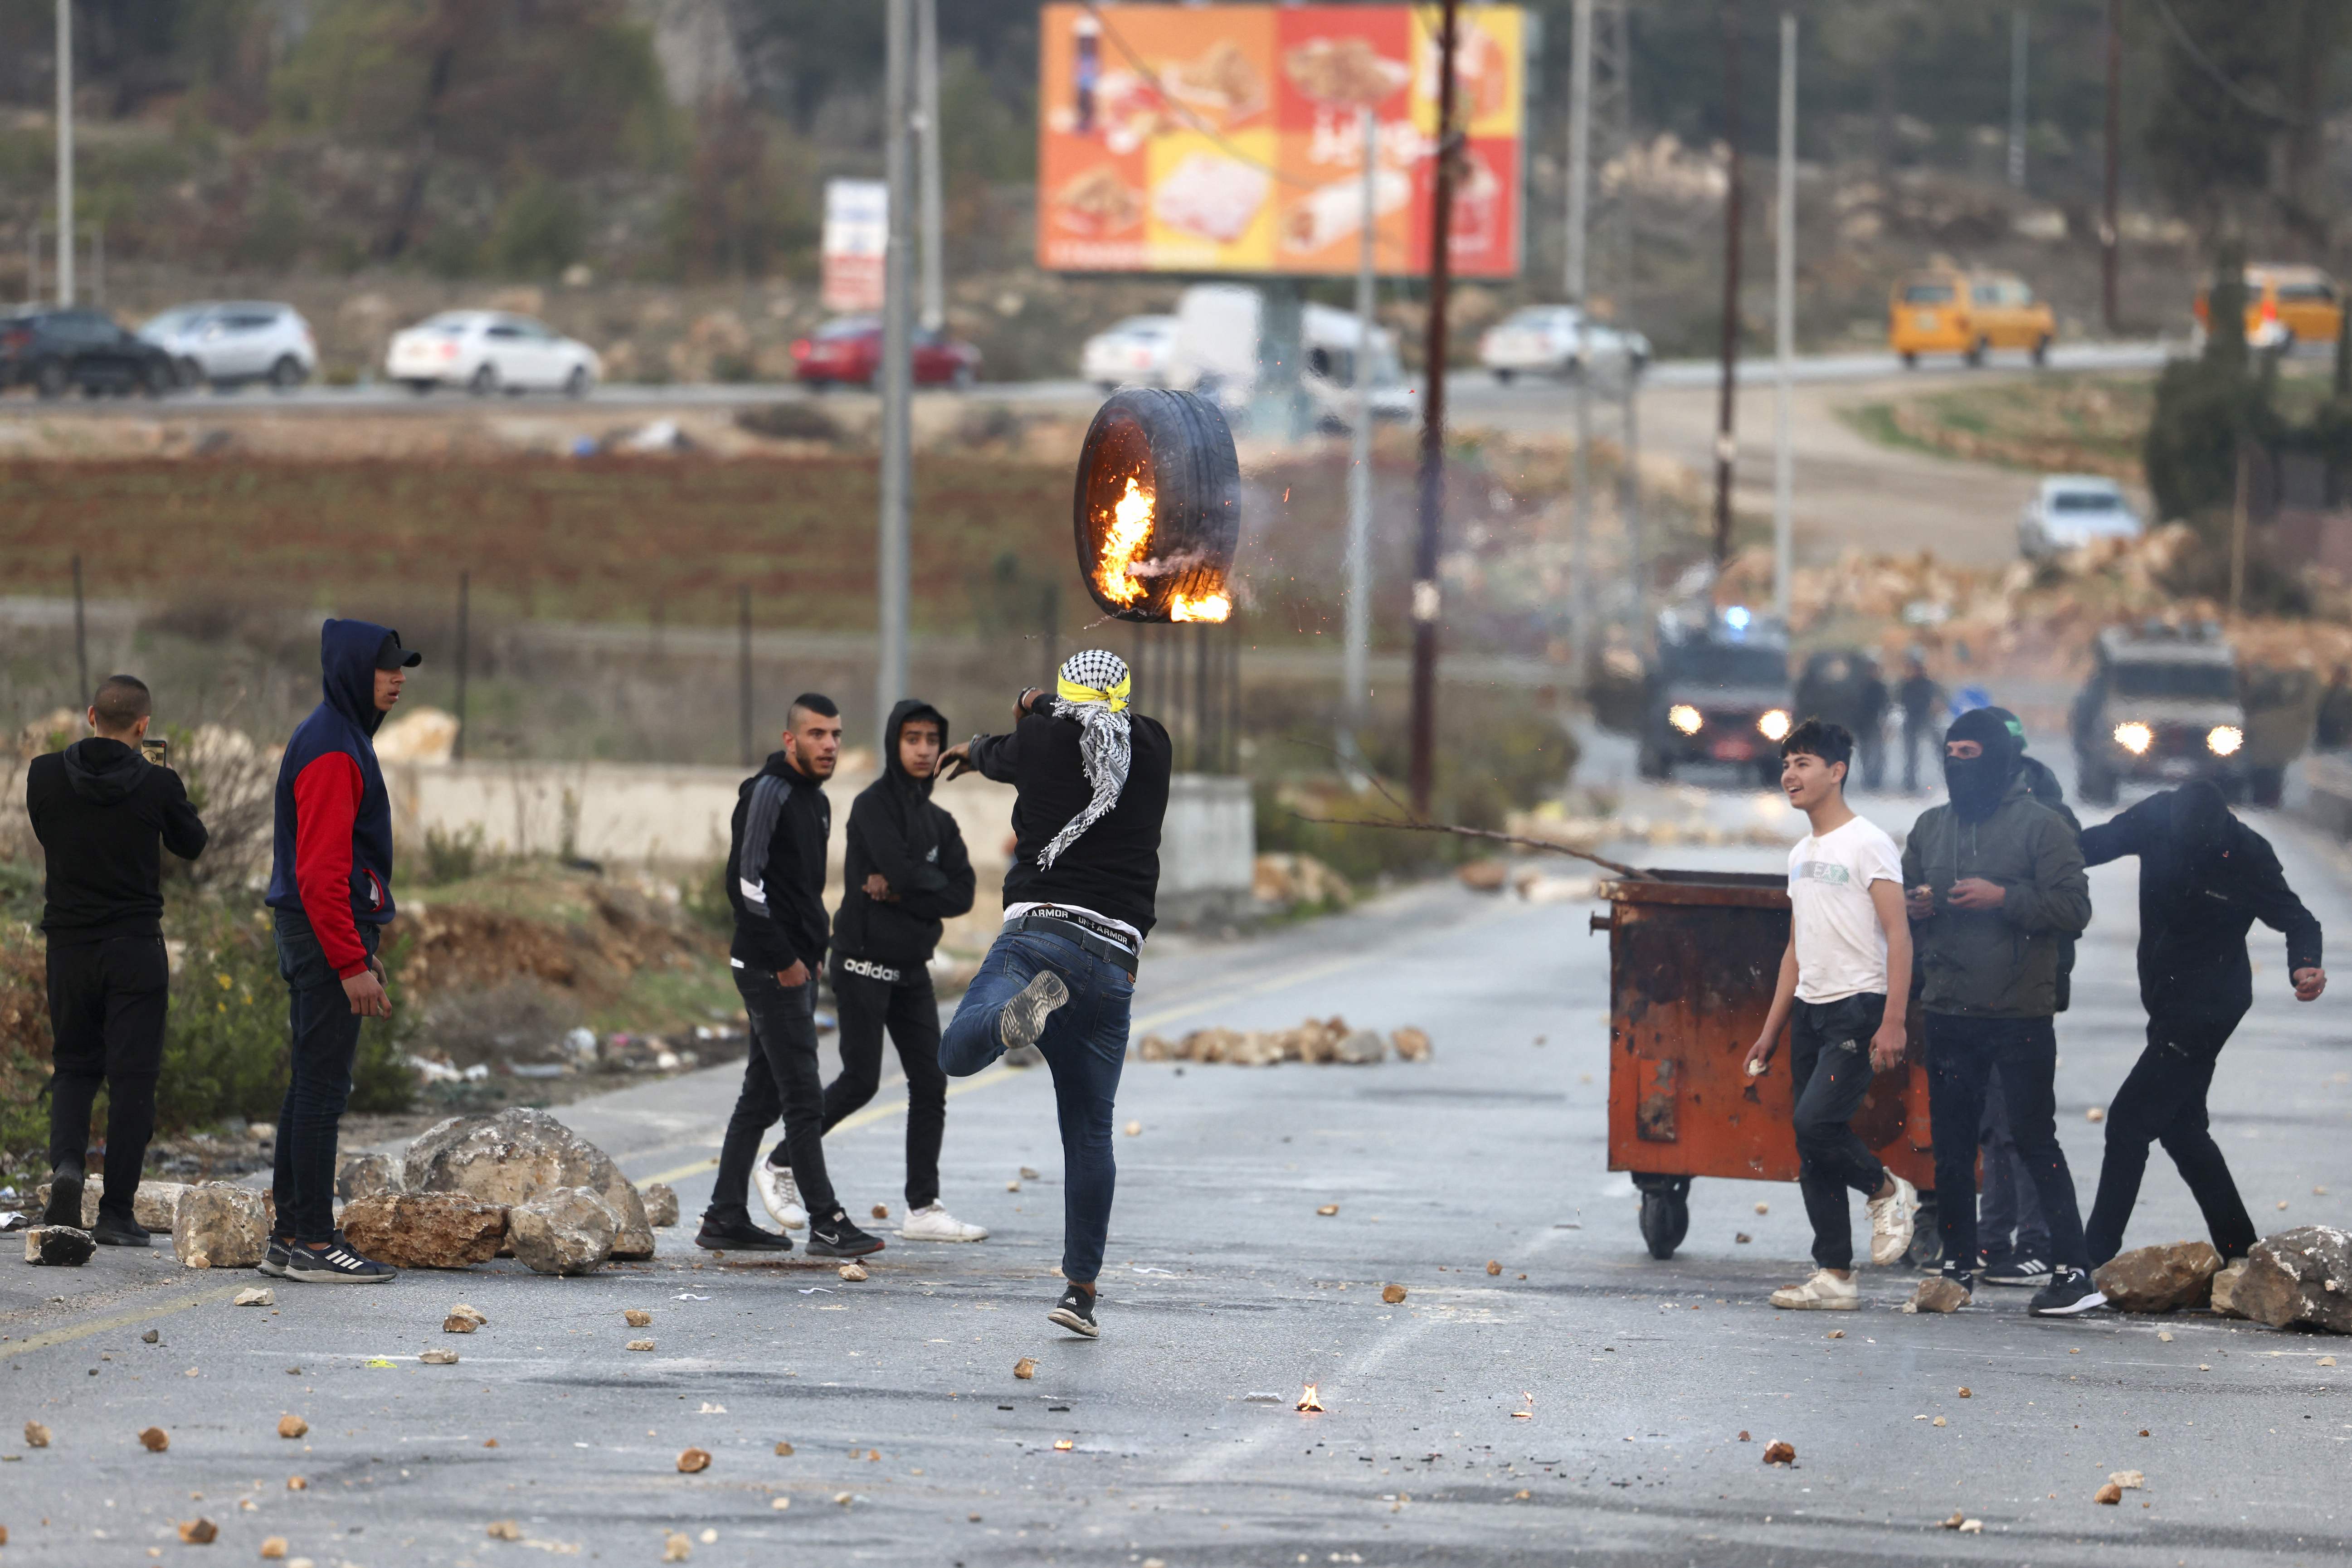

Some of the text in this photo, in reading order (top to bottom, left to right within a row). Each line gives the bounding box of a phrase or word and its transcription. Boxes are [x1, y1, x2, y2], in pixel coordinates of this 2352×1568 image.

[1032, 909, 1068, 918] ARMOR
[1097, 926, 1128, 945] ARMOR
[844, 958, 901, 981] adidas
